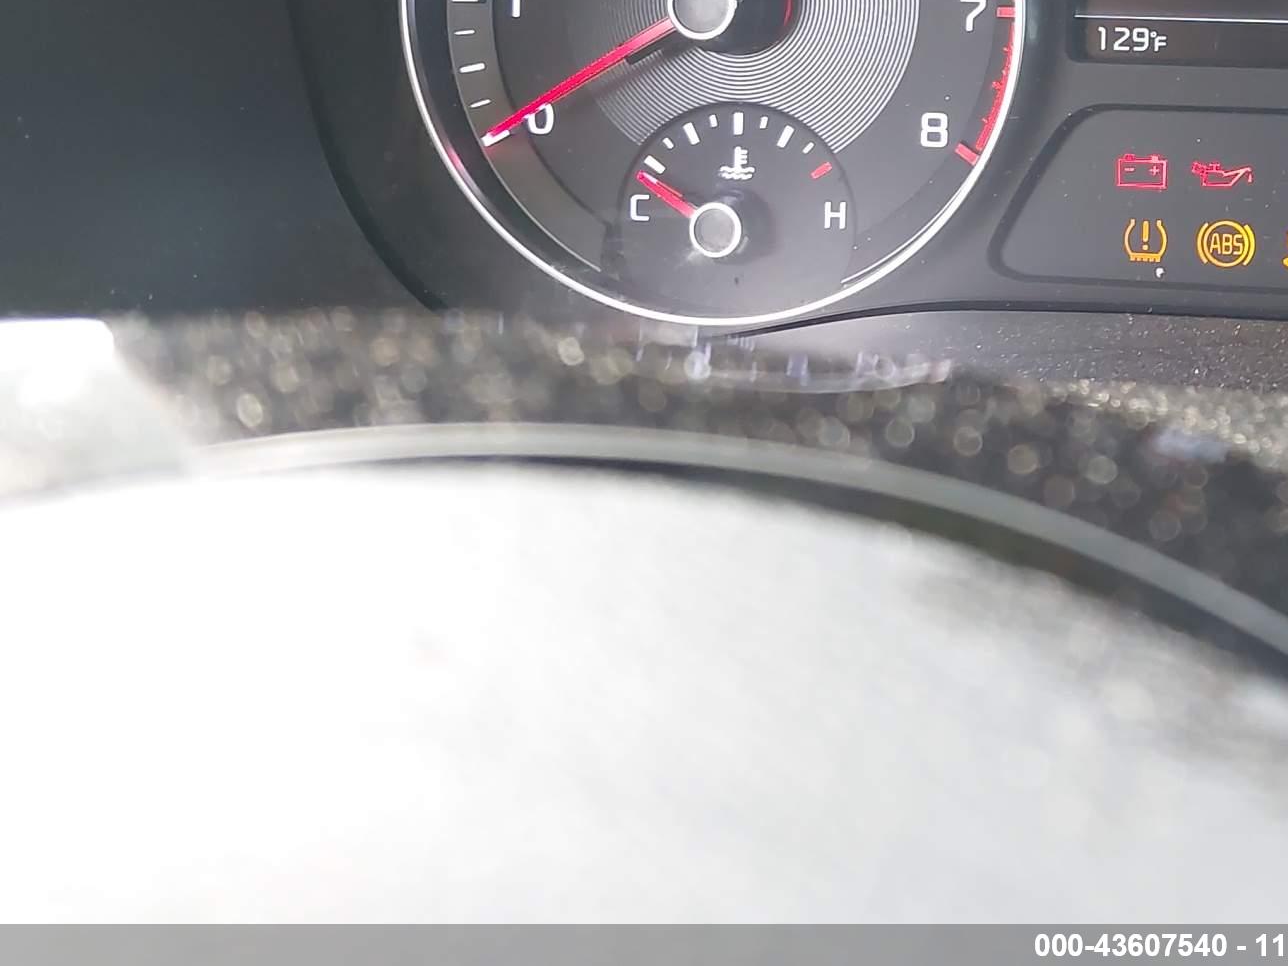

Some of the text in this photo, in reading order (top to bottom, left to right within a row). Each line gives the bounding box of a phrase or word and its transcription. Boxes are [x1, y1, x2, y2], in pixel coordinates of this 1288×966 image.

[919, 113, 950, 148] 8
[629, 195, 650, 221] C
[824, 204, 847, 229] H
[1209, 234, 1244, 254] ABS
